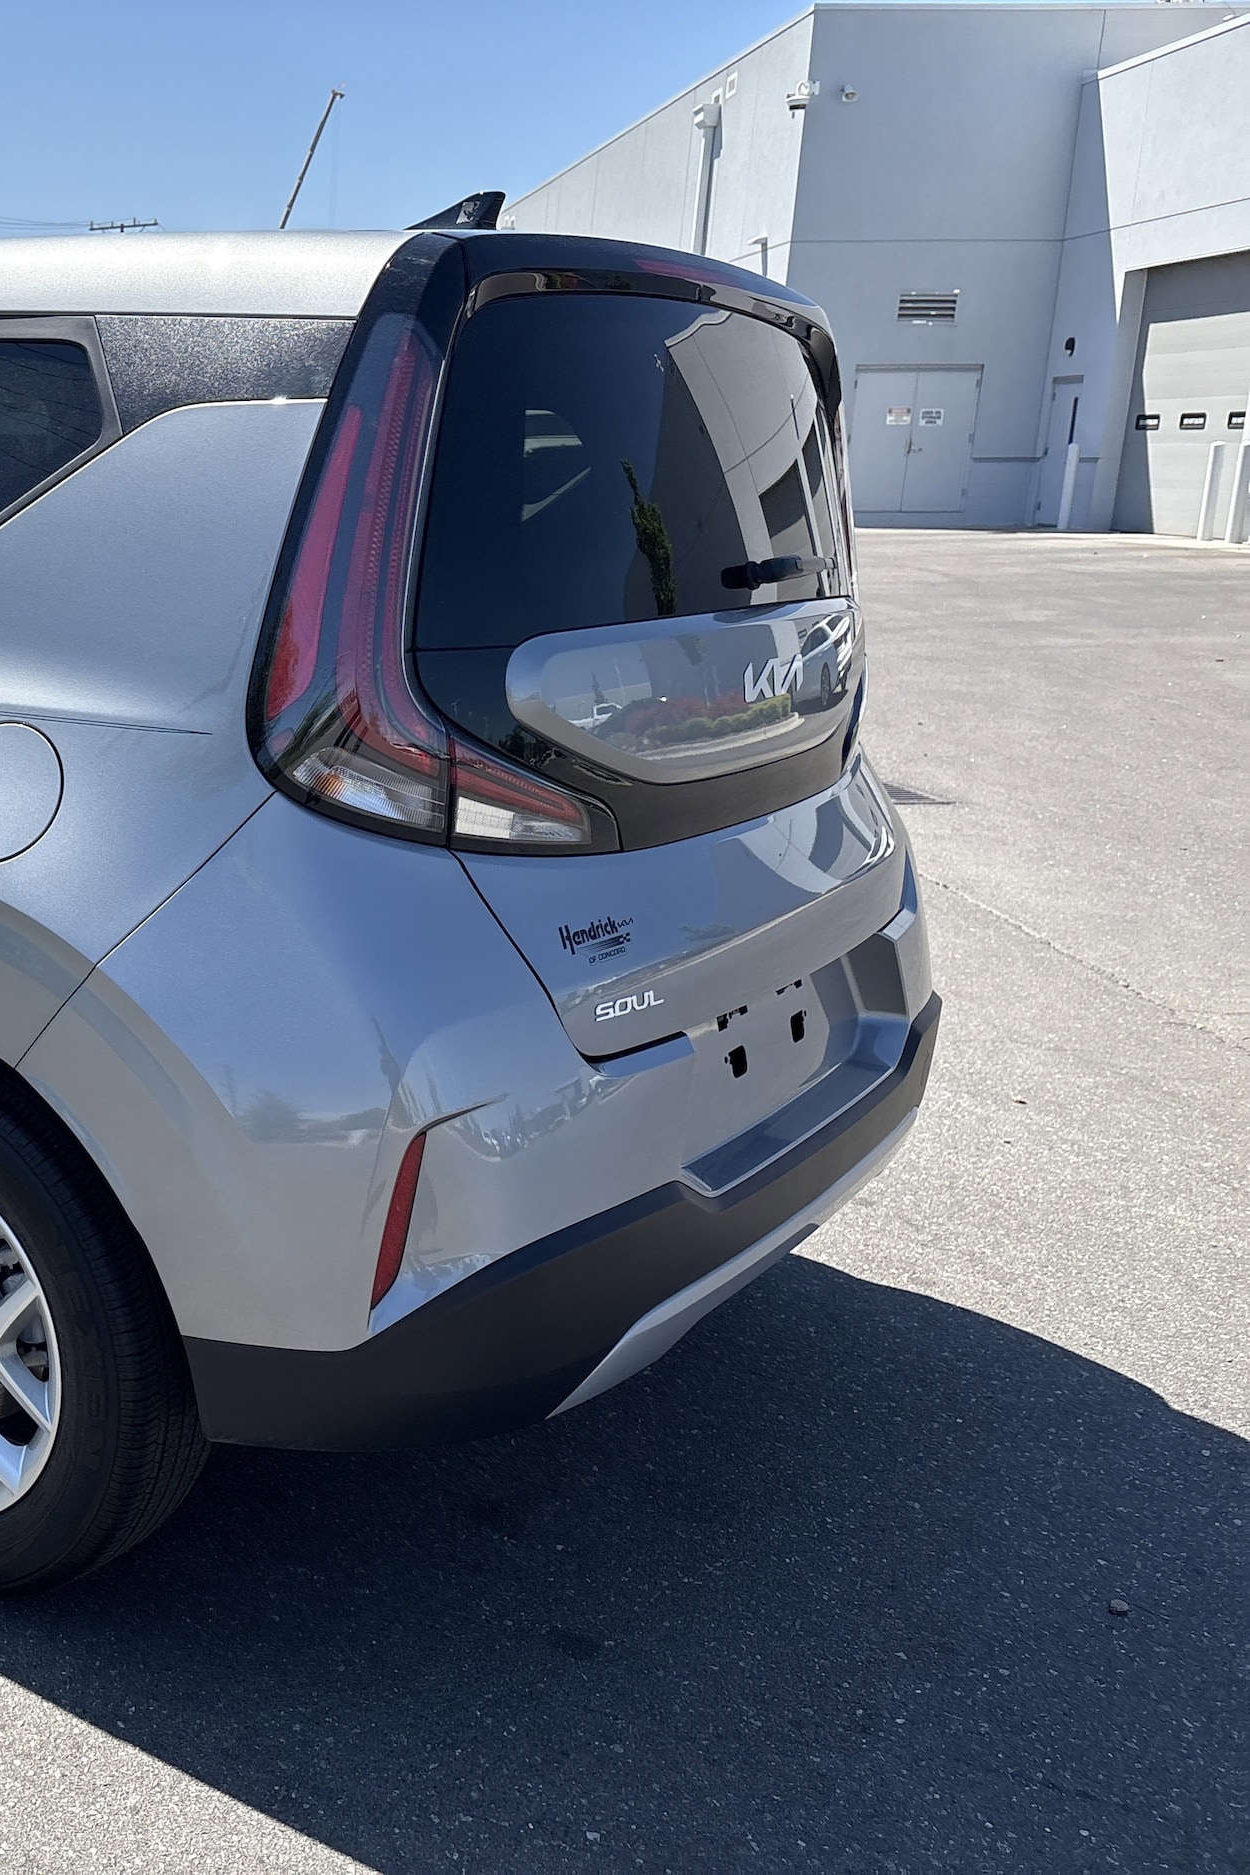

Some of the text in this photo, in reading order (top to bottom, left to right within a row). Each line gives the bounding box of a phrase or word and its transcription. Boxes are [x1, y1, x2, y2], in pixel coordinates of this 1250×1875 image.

[743, 653, 803, 703] KIA
[558, 916, 618, 955] Hendrick
[589, 946, 626, 964] OF CONCORD
[594, 990, 664, 1022] SOUL
